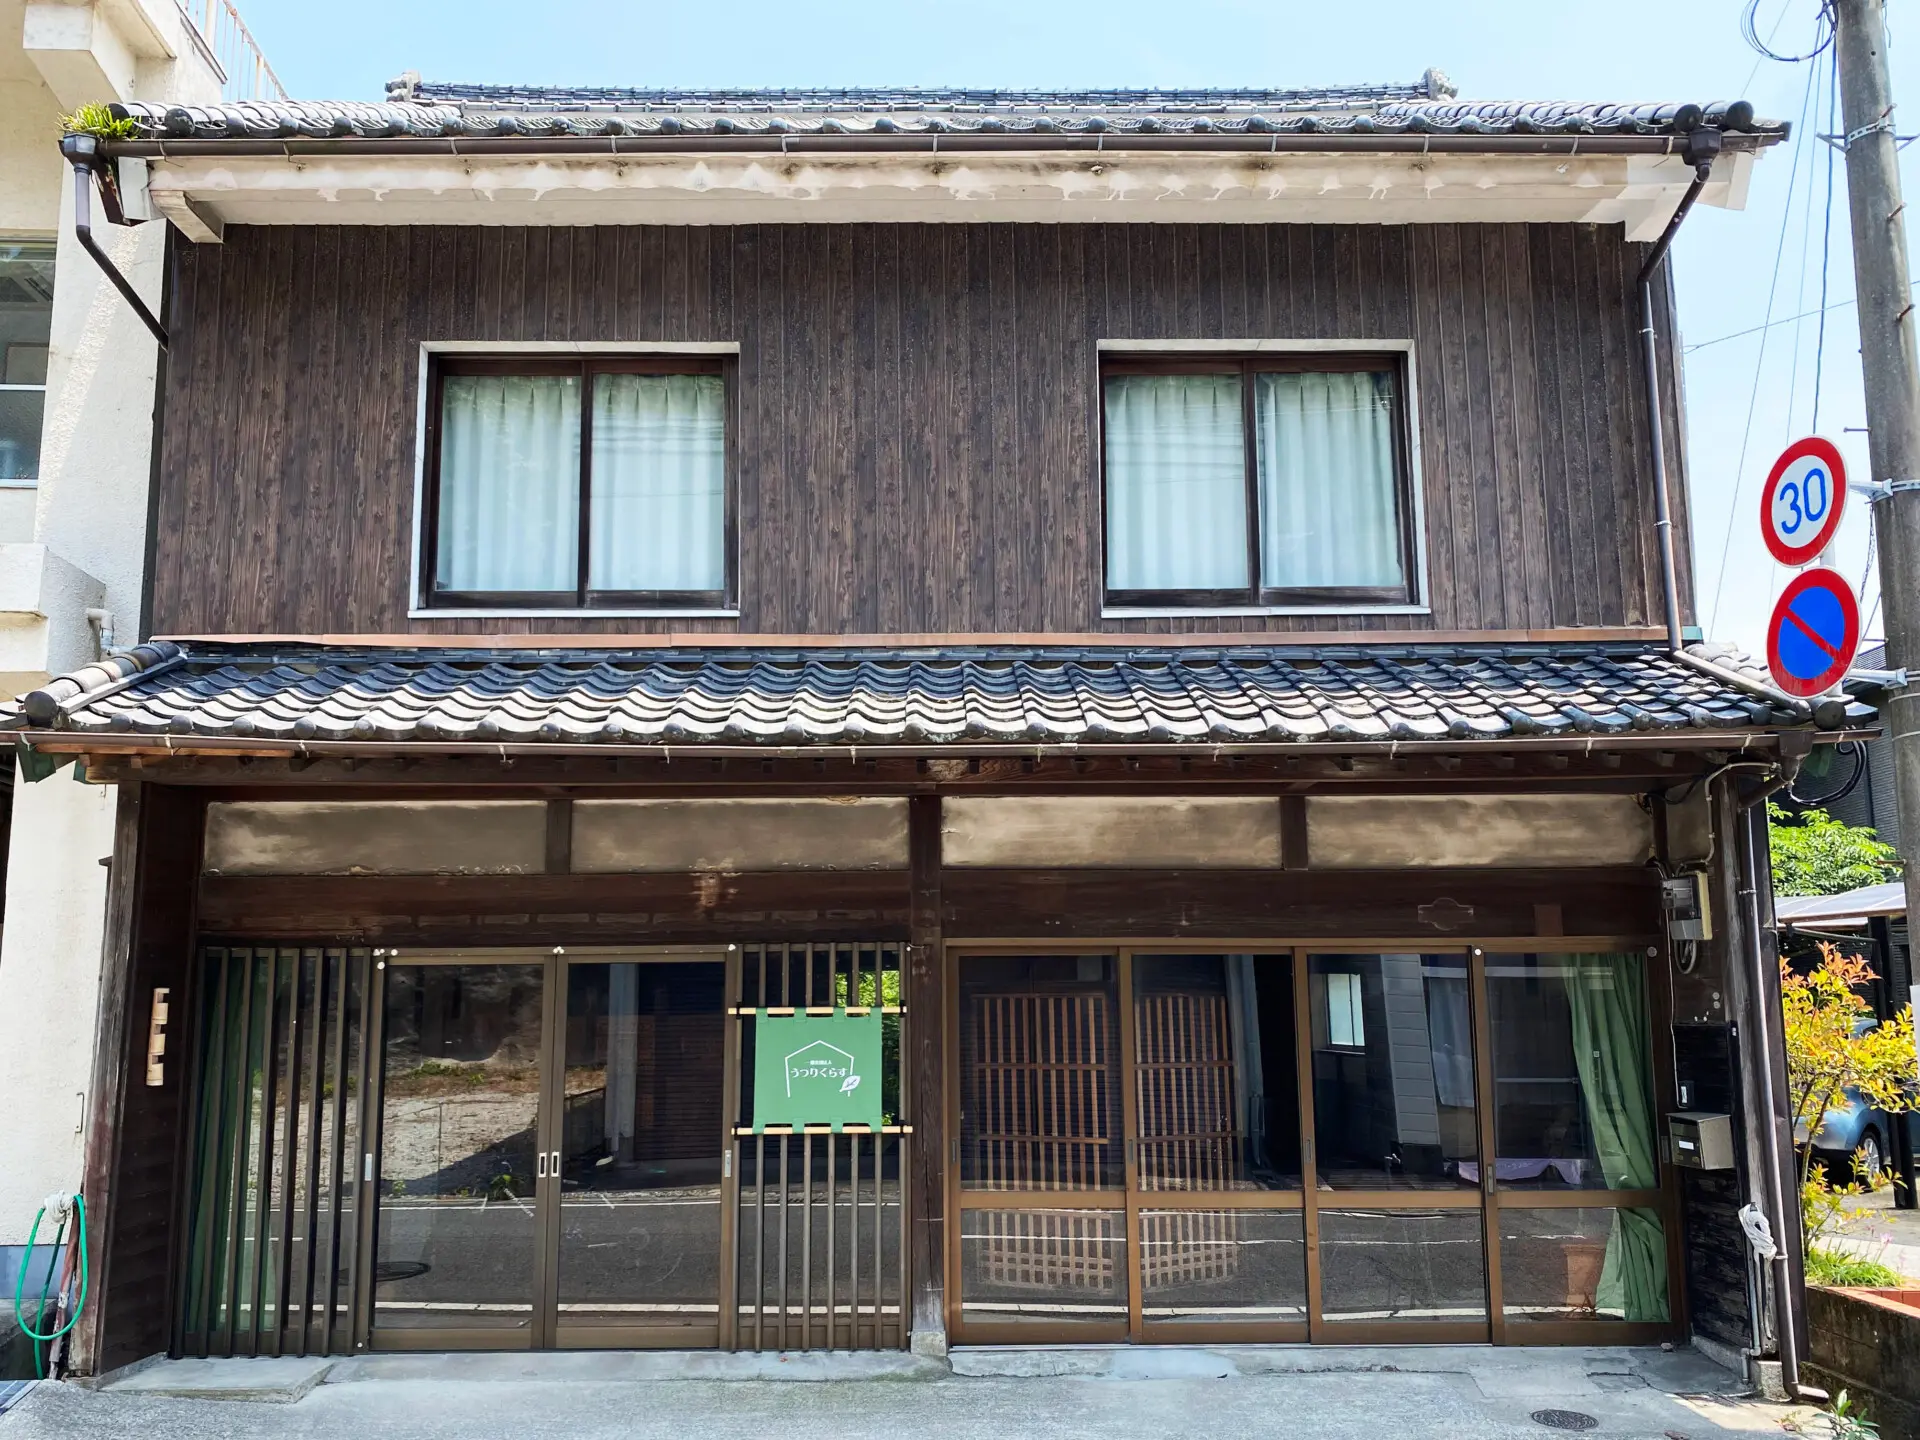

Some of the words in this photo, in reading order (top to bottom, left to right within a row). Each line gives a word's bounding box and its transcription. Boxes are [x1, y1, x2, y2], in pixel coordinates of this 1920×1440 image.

[1780, 468, 1826, 534] 30
[790, 1067, 848, 1078] うつりくらす
